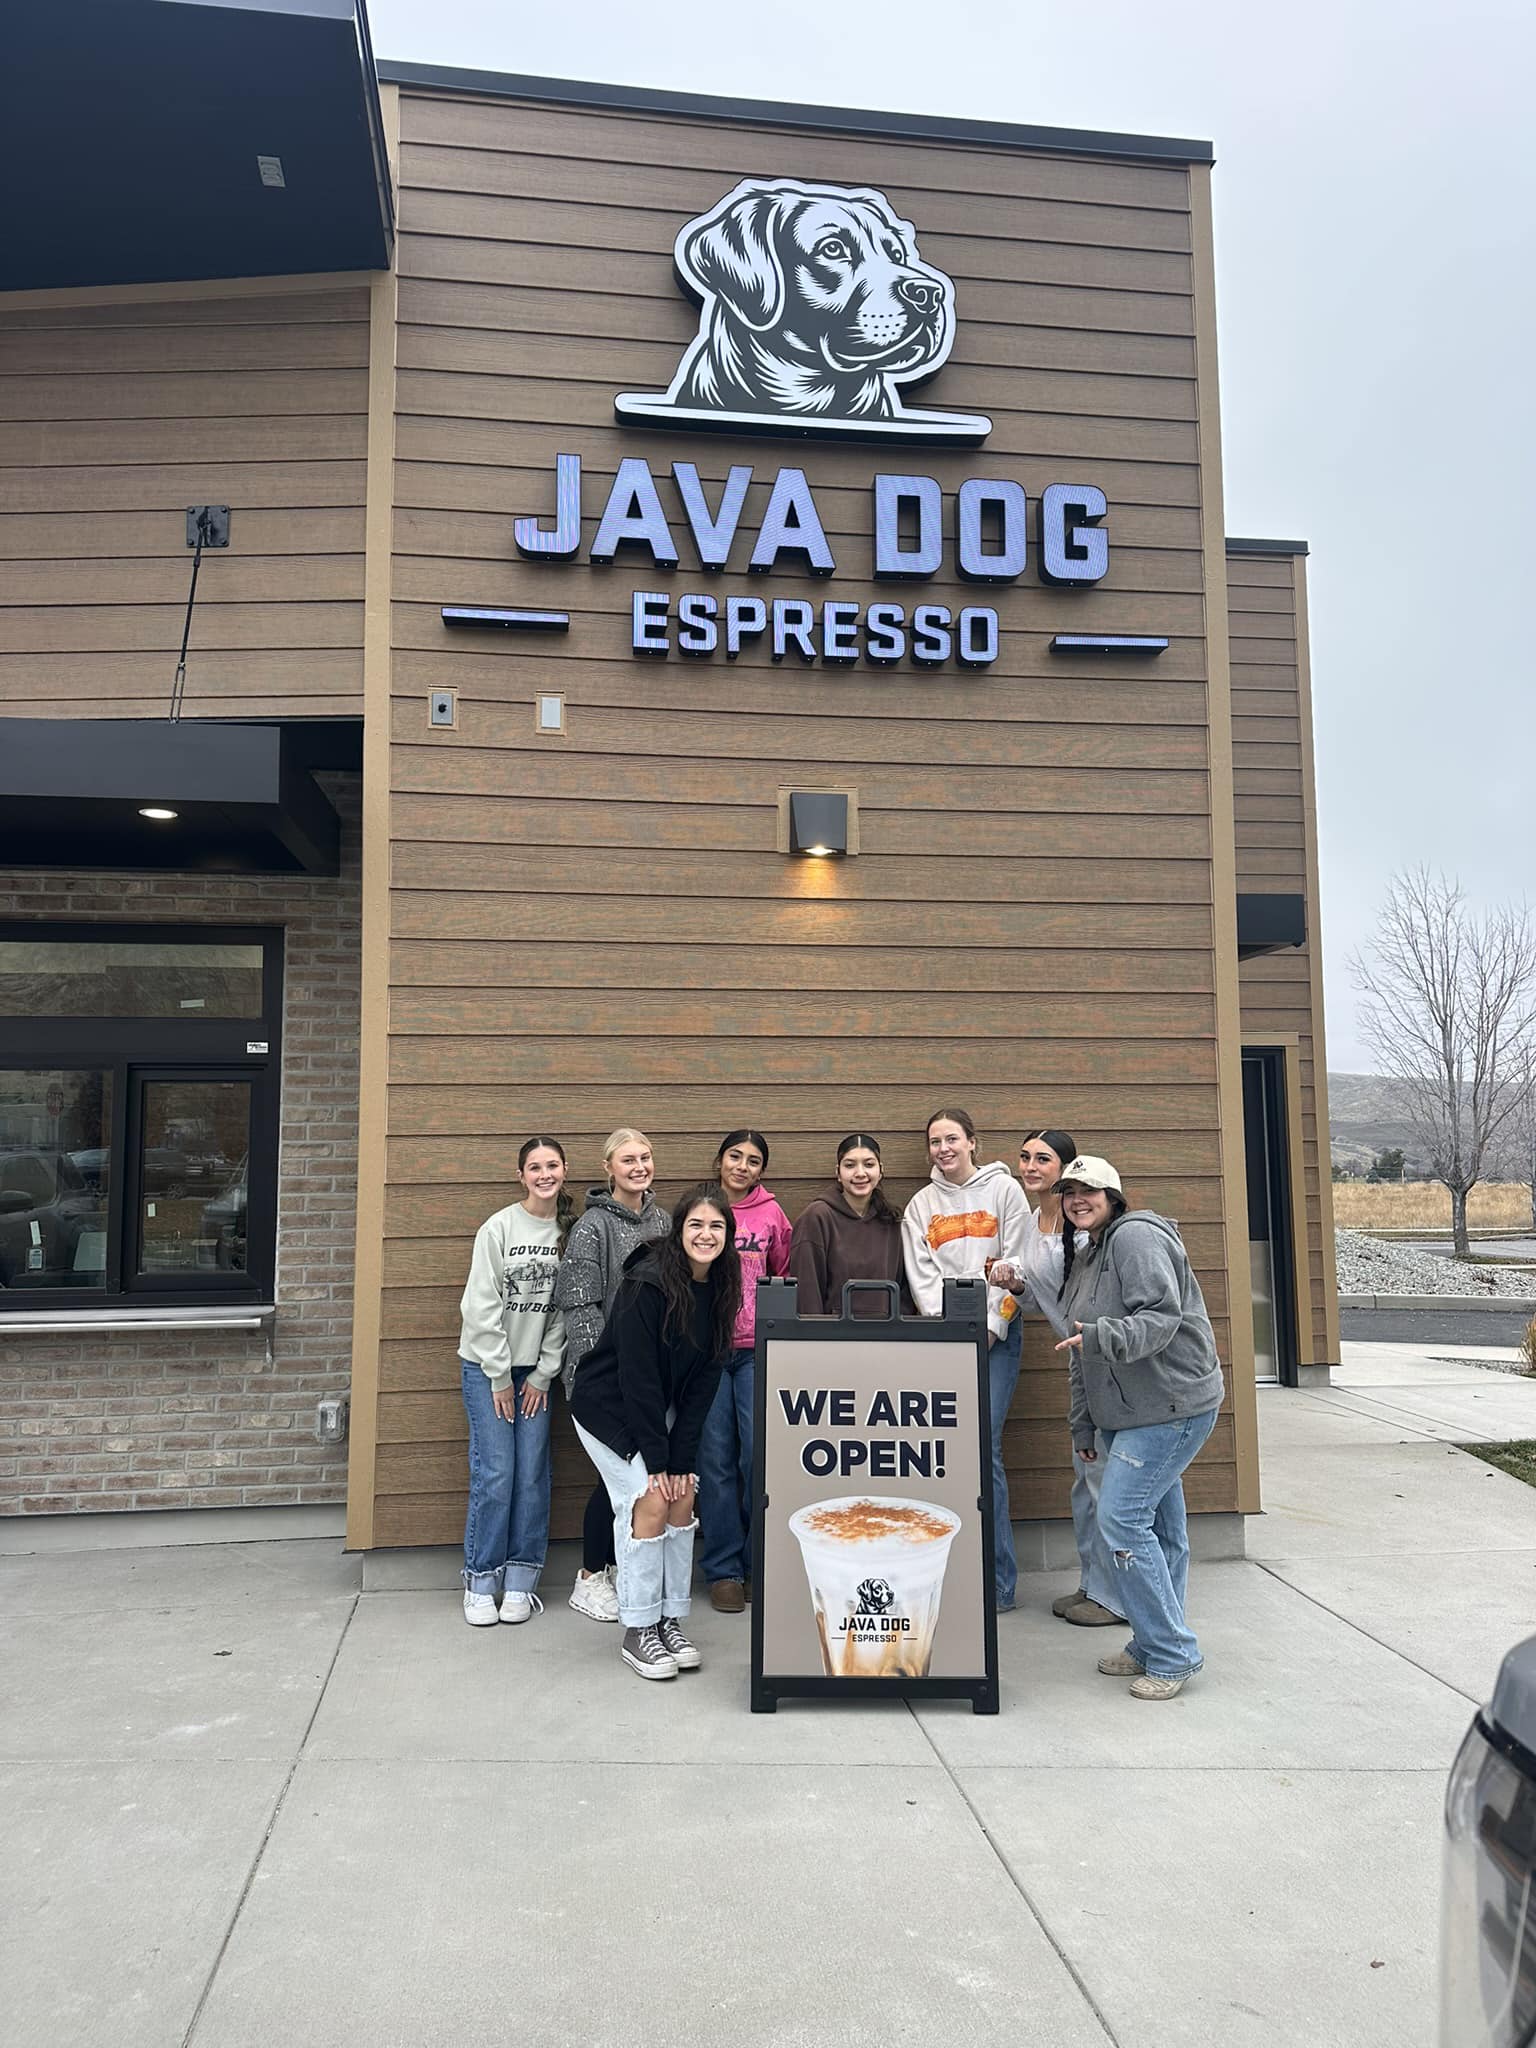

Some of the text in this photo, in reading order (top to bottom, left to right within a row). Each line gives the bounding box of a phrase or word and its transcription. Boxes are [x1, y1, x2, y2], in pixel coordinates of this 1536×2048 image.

[513, 453, 1110, 587] JAVA DOG
[631, 590, 999, 667] ESPRESSO
[509, 1245, 558, 1256] COWBO
[778, 1389, 958, 1428] WE ARE
[801, 1440, 946, 1479] OPEN!
[838, 1617, 910, 1631] JAVA DOG
[852, 1634, 897, 1643] ESPRESSO
